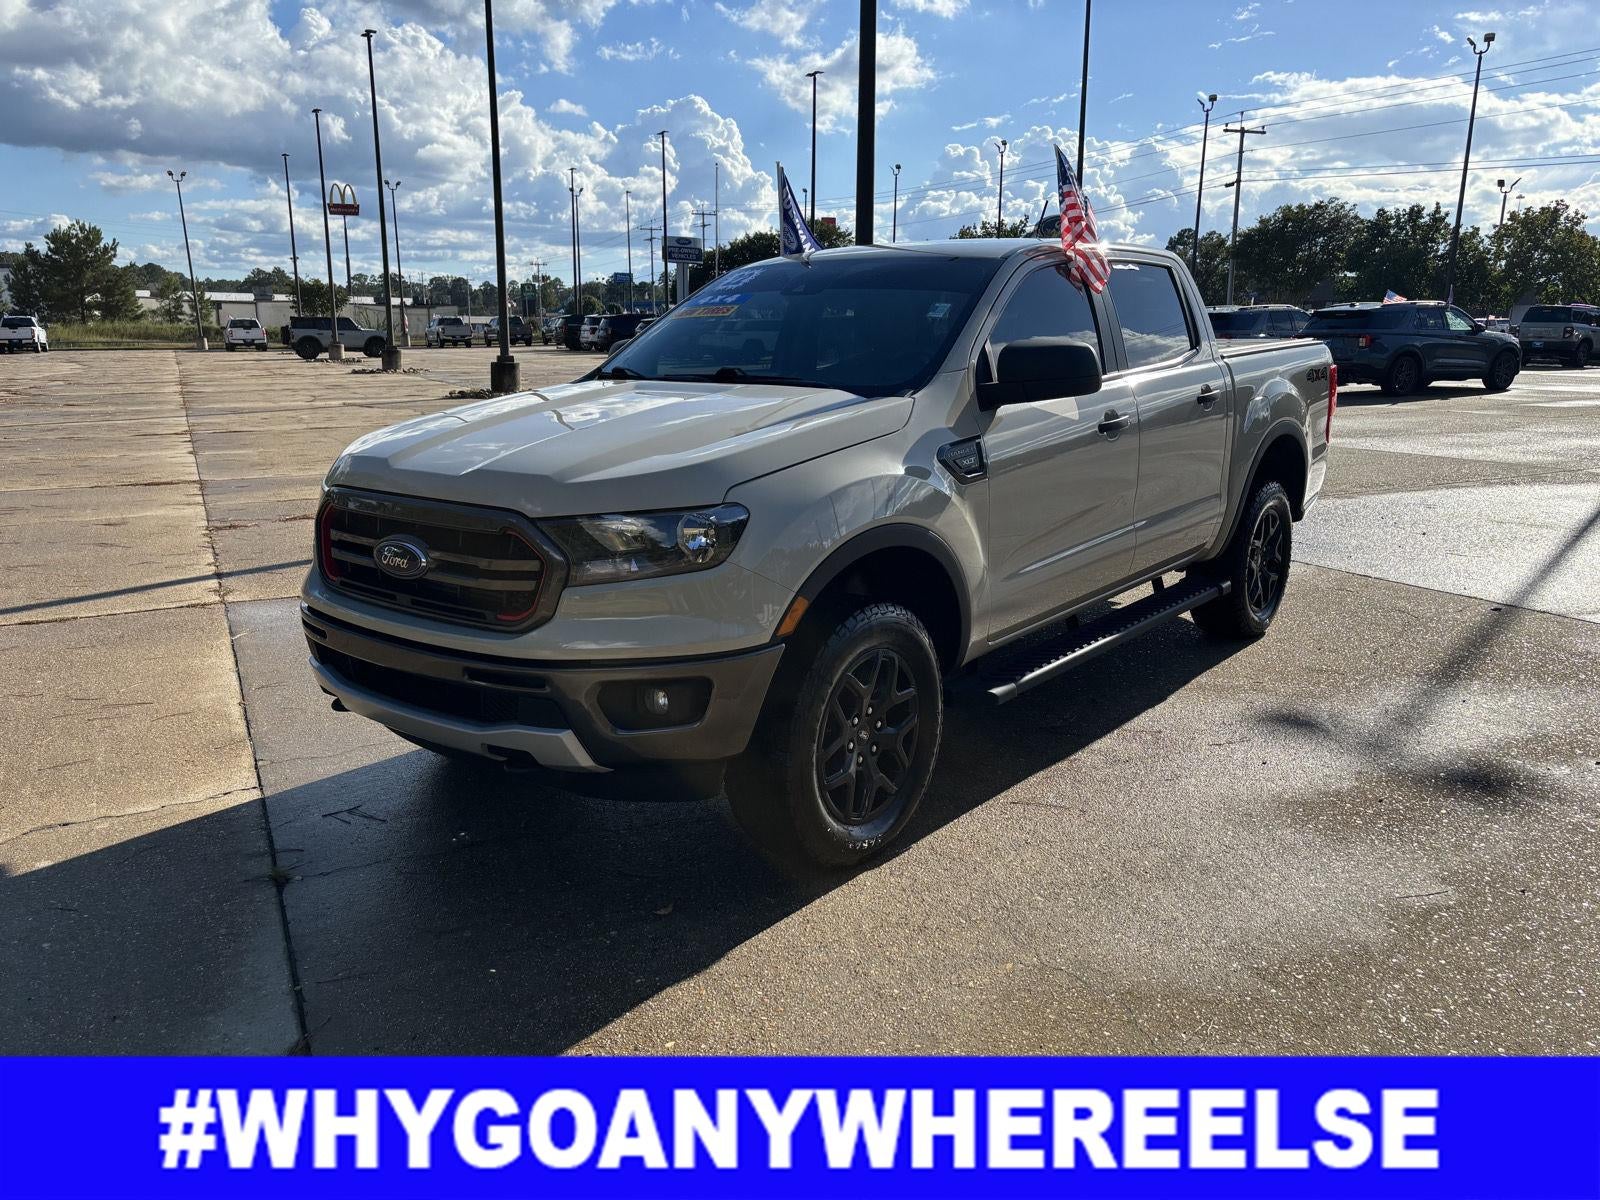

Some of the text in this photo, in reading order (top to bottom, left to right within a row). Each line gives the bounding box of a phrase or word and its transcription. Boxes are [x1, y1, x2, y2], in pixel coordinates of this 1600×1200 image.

[668, 247, 700, 255] PRE-OWNED
[962, 456, 976, 466] XLT
[381, 545, 410, 569] Ford
